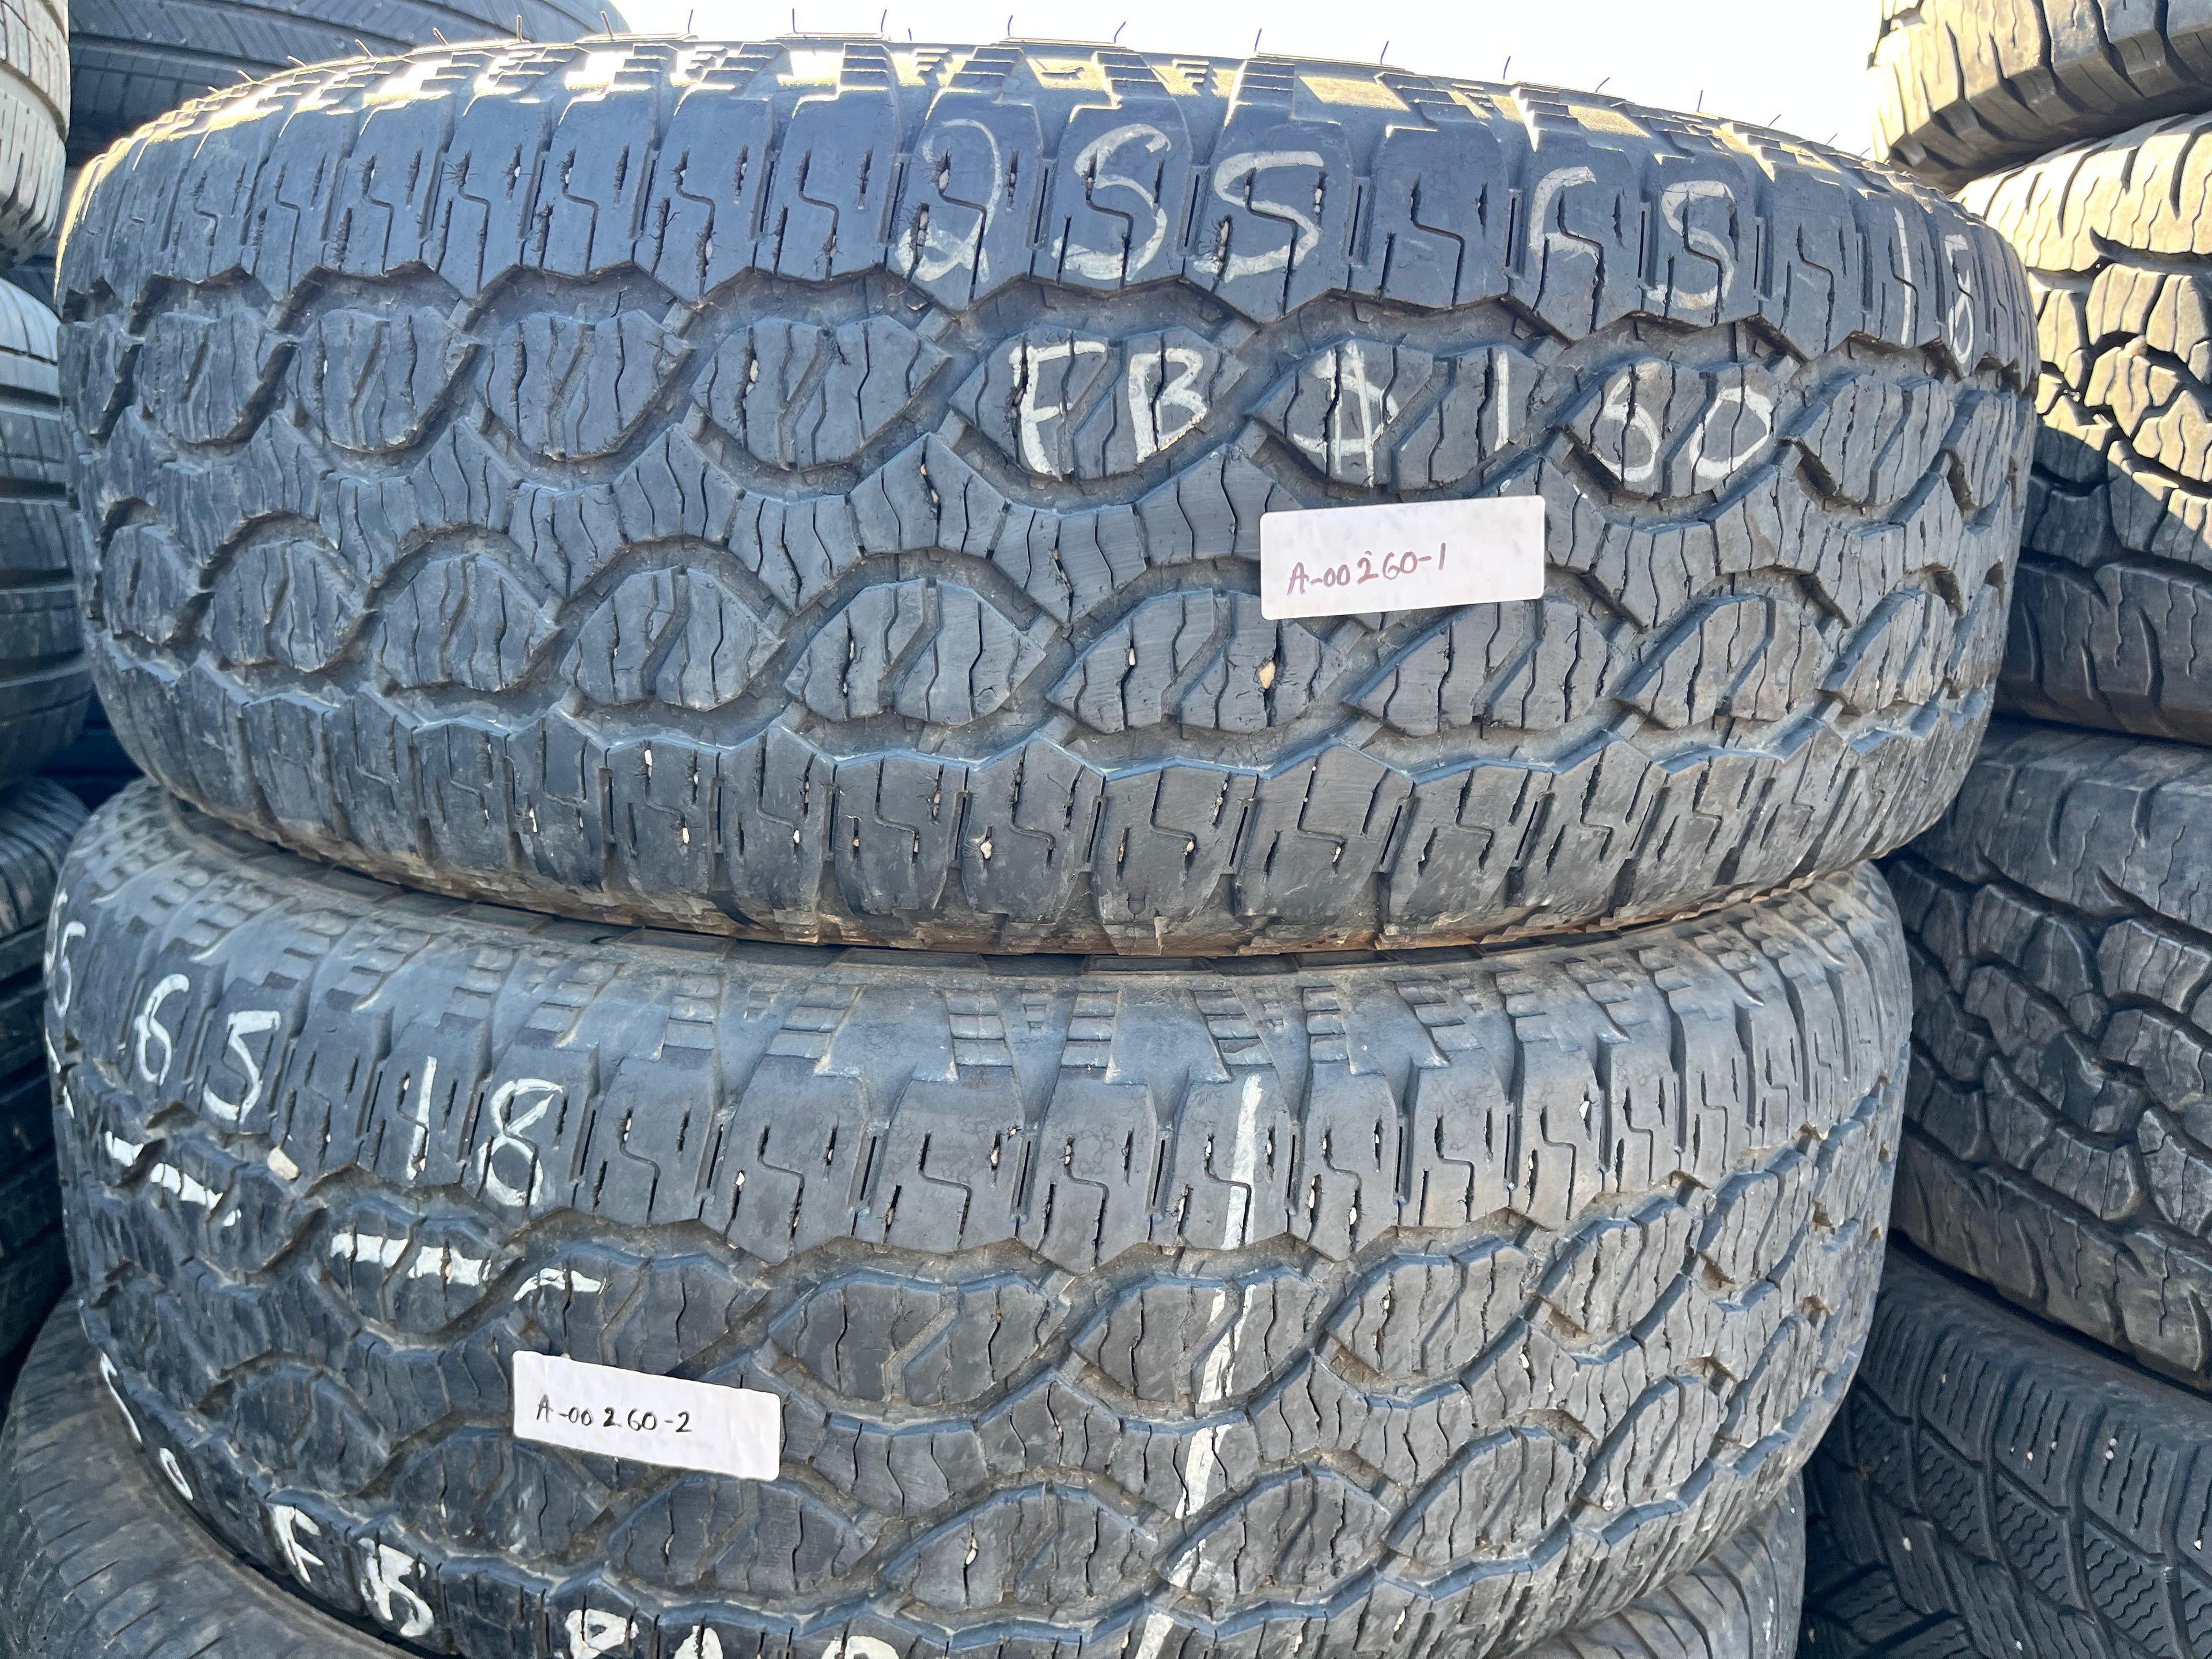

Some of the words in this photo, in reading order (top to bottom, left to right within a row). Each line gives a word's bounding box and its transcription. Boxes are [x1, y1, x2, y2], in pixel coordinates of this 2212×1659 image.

[895, 118, 1324, 283] 255
[1009, 342, 1210, 481] FB
[134, 973, 282, 1125] 65
[406, 1055, 565, 1206] 18
